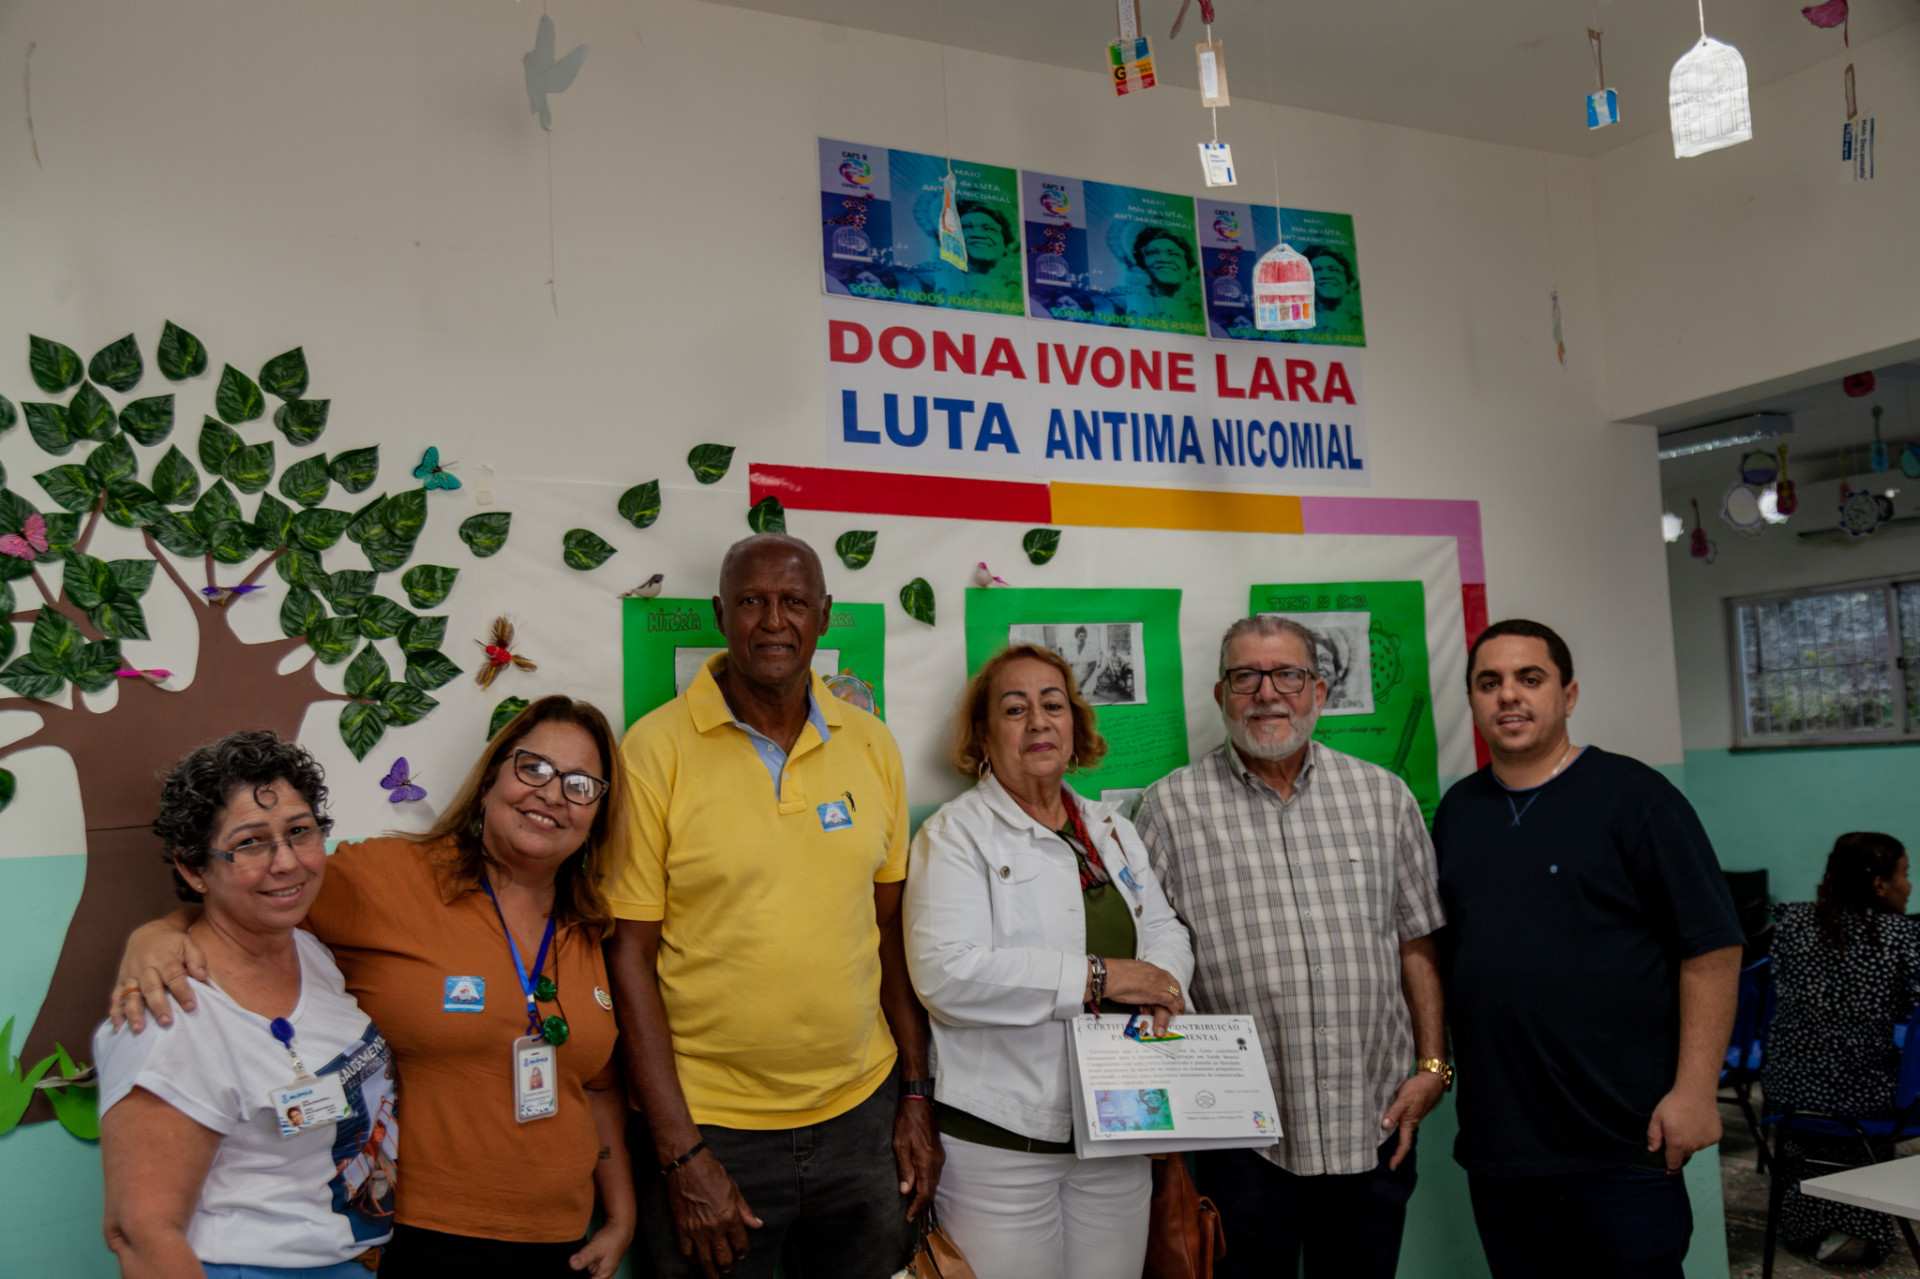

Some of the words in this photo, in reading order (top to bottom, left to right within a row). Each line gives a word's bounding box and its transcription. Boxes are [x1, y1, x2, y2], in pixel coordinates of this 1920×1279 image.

[1114, 66, 1127, 81] G
[954, 169, 981, 178] MAIO
[975, 181, 1000, 192] LUTA
[1142, 197, 1165, 206] MAIO
[1159, 210, 1183, 219] LUTA
[850, 283, 896, 298] SOMOS
[901, 289, 944, 304] TODOS
[947, 295, 981, 310] JOIAS
[985, 299, 1024, 313] RARAS
[1051, 307, 1093, 321] SOMOS
[1098, 312, 1136, 326] TODOS
[1138, 317, 1168, 330] JOIAS
[1171, 321, 1207, 334] RARAS
[1269, 330, 1304, 341] TODOS
[1335, 333, 1365, 344] RARAS
[829, 320, 1026, 381] DONA
[1037, 342, 1197, 393] IVONE
[1215, 353, 1357, 405] LARA
[842, 389, 1021, 455] LUTA
[827, 613, 856, 627] ARA
[1169, 1022, 1240, 1033] CONTRIBUIÇÃO
